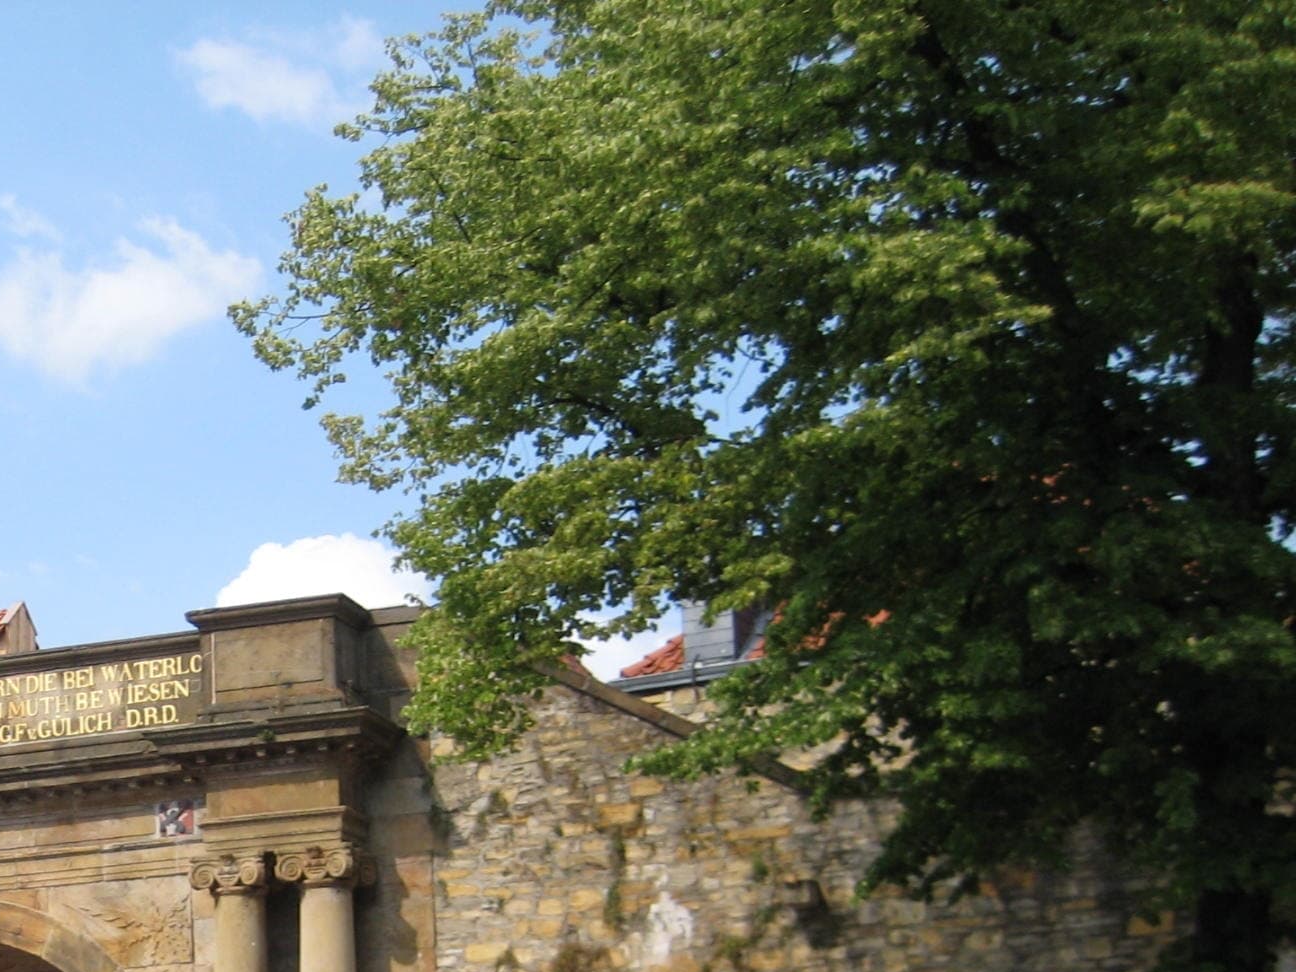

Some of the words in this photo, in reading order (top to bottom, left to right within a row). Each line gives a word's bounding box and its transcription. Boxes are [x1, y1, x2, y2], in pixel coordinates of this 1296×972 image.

[26, 672, 57, 694] DIE
[64, 667, 95, 689] BEI
[6, 693, 71, 720] MUTH
